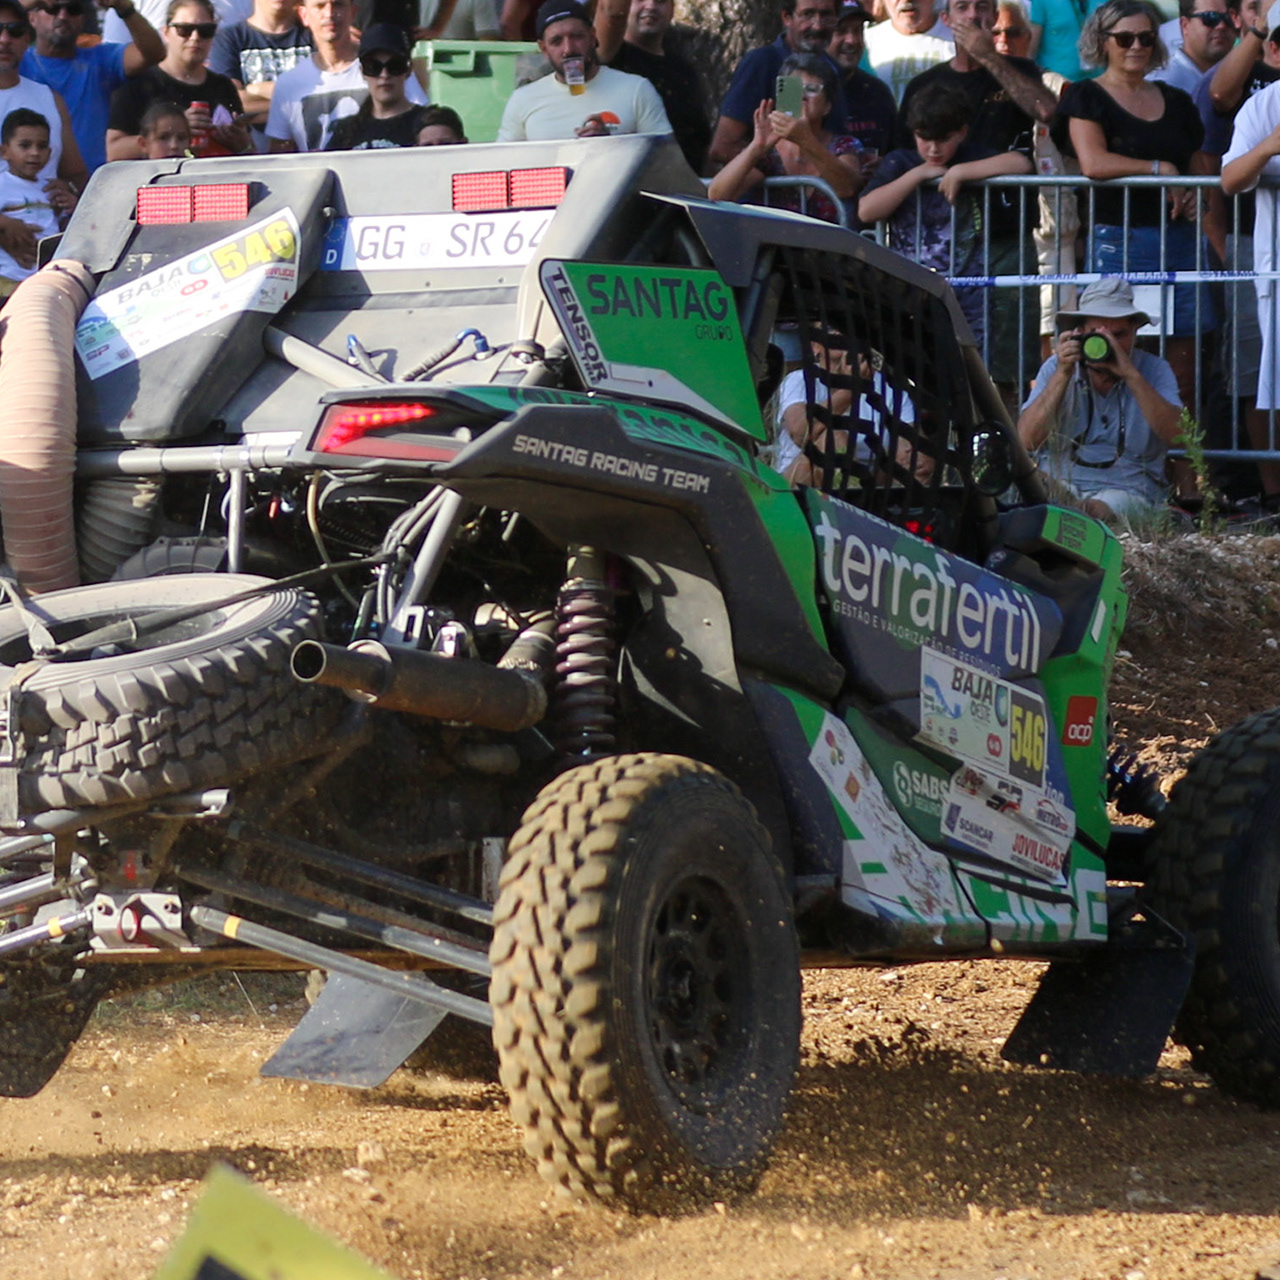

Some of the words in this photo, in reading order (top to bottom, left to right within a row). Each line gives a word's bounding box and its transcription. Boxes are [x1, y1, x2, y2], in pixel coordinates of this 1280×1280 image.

[212, 220, 295, 279] 546
[325, 249, 338, 265] D
[356, 224, 407, 261] GG
[445, 222, 496, 258] SR
[117, 264, 184, 305] BAJA
[586, 274, 729, 322] SANTAG
[551, 267, 608, 383] TENSOR
[695, 324, 733, 342] GRUPO
[512, 434, 588, 467] SANTAG
[590, 451, 658, 484] RACING
[663, 468, 710, 494] TEAM
[815, 510, 1041, 674] terrafertil
[833, 599, 870, 623] GESTÃO
[872, 615, 879, 628] E
[951, 666, 994, 706] BAJA
[1010, 703, 1045, 772] 546
[1067, 723, 1093, 742] acp
[959, 817, 994, 843] SCANCAR
[1012, 831, 1065, 871] JOVILUCAS
